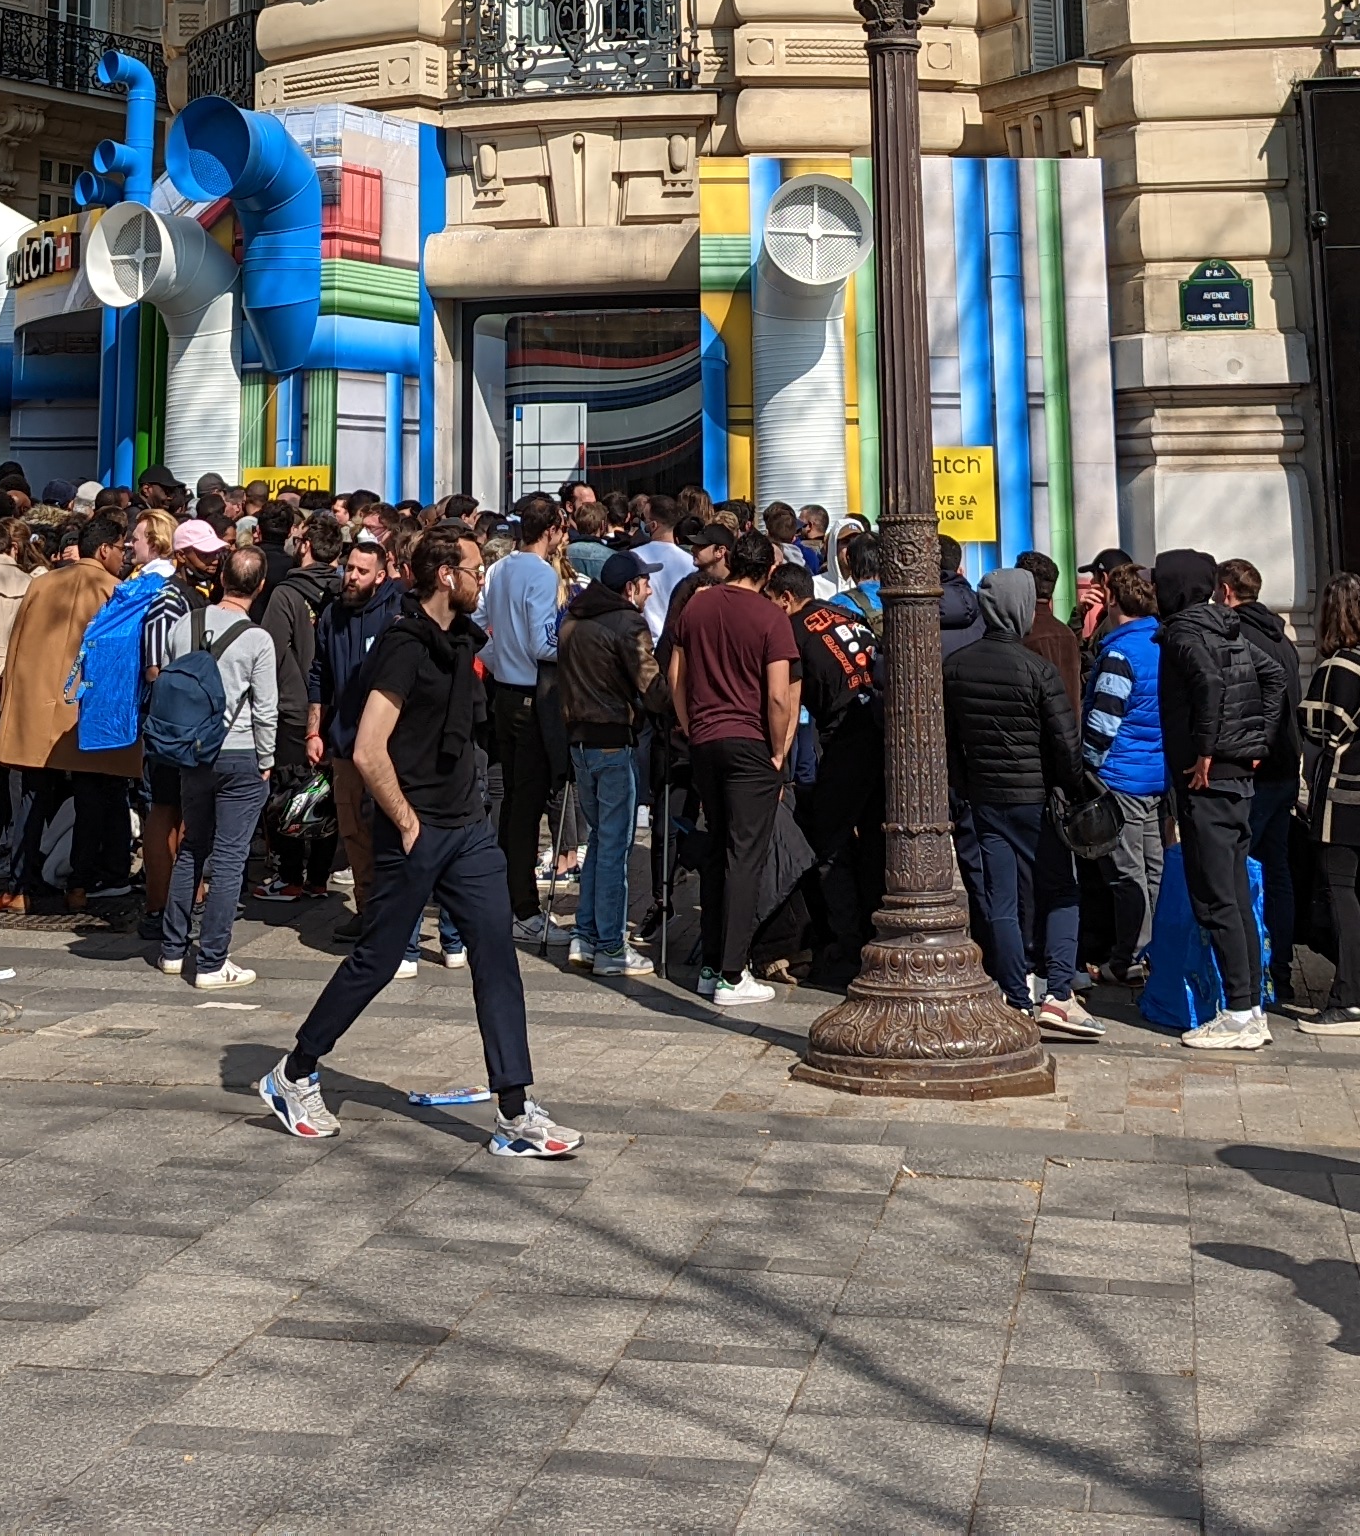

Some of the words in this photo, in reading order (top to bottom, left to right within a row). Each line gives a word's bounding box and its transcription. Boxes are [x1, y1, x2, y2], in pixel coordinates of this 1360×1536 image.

[1202, 291, 1231, 300] AVENUE
[1186, 313, 1217, 322] CHAMPS
[959, 495, 978, 505] SA
